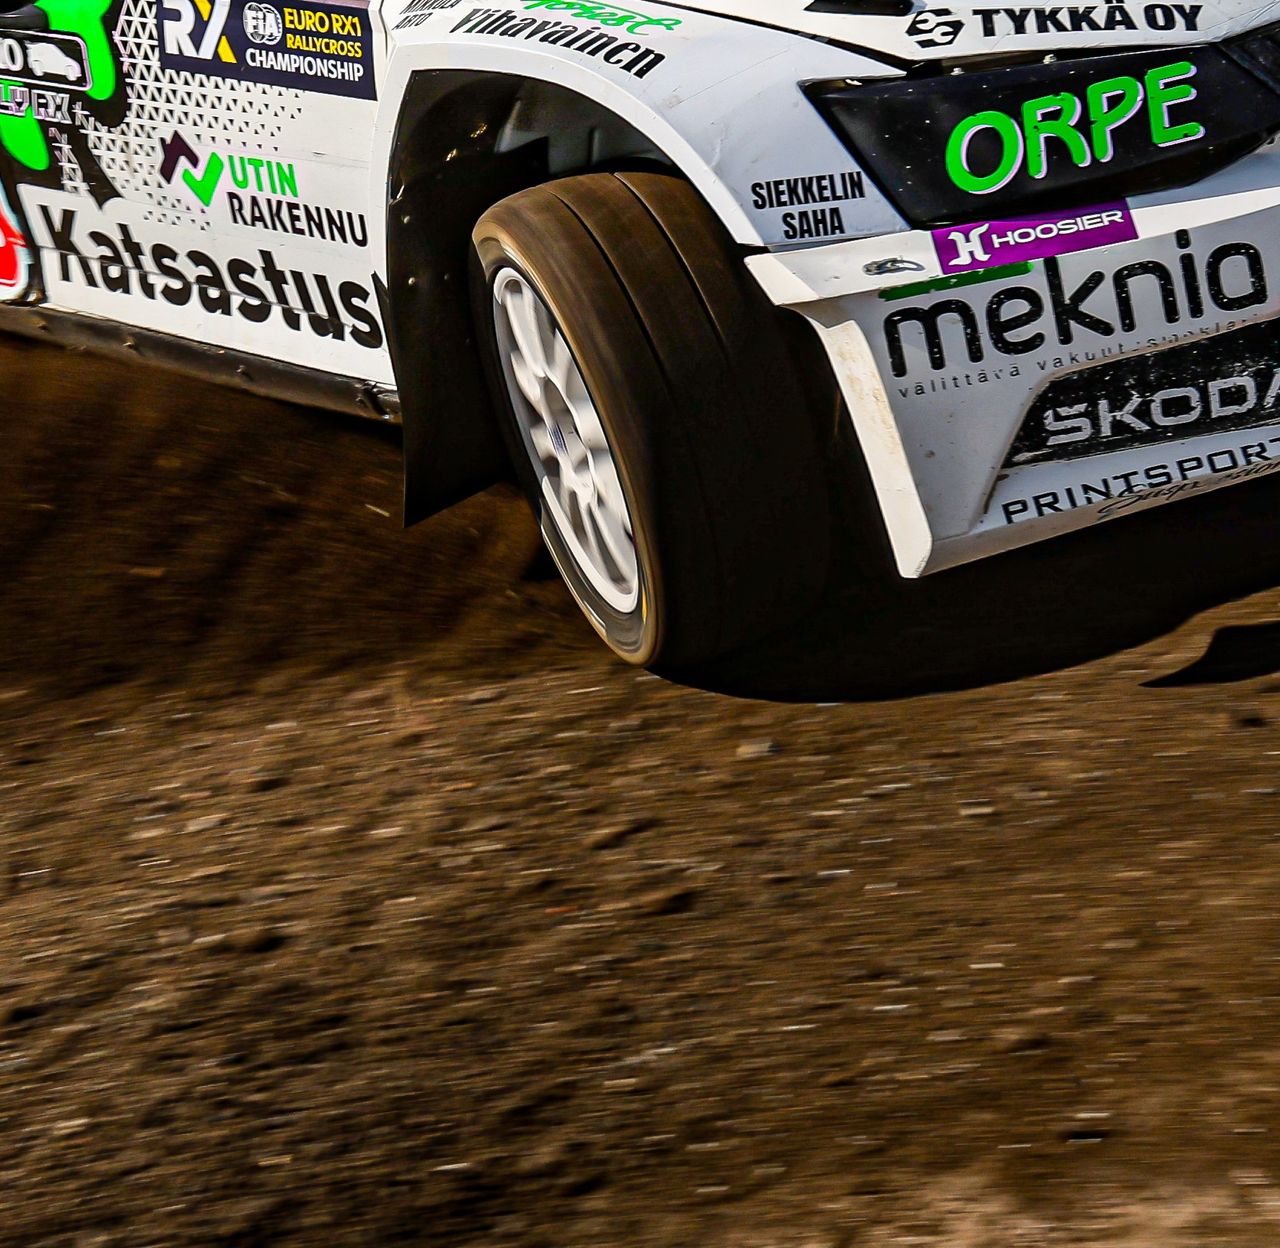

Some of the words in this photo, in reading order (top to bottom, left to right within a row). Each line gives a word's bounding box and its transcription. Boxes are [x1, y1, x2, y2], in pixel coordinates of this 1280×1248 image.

[283, 7, 329, 33] EURO
[332, 13, 362, 36] RX1
[391, 12, 434, 30] ARTO
[1143, 2, 1205, 32] OY
[286, 33, 363, 58] RALLYCROSS
[449, 8, 666, 79] Vihavainen
[246, 48, 364, 81] CHAMPIONSHIP
[945, 60, 1207, 196] ORPE
[227, 154, 299, 198] UTIN
[751, 171, 866, 210] SIEKKELIN
[227, 191, 369, 248] RAKENNU
[783, 206, 846, 240] SAHA
[991, 209, 1124, 249] HOOSIER
[36, 204, 384, 349] Katsastus
[883, 229, 1269, 379] meknia
